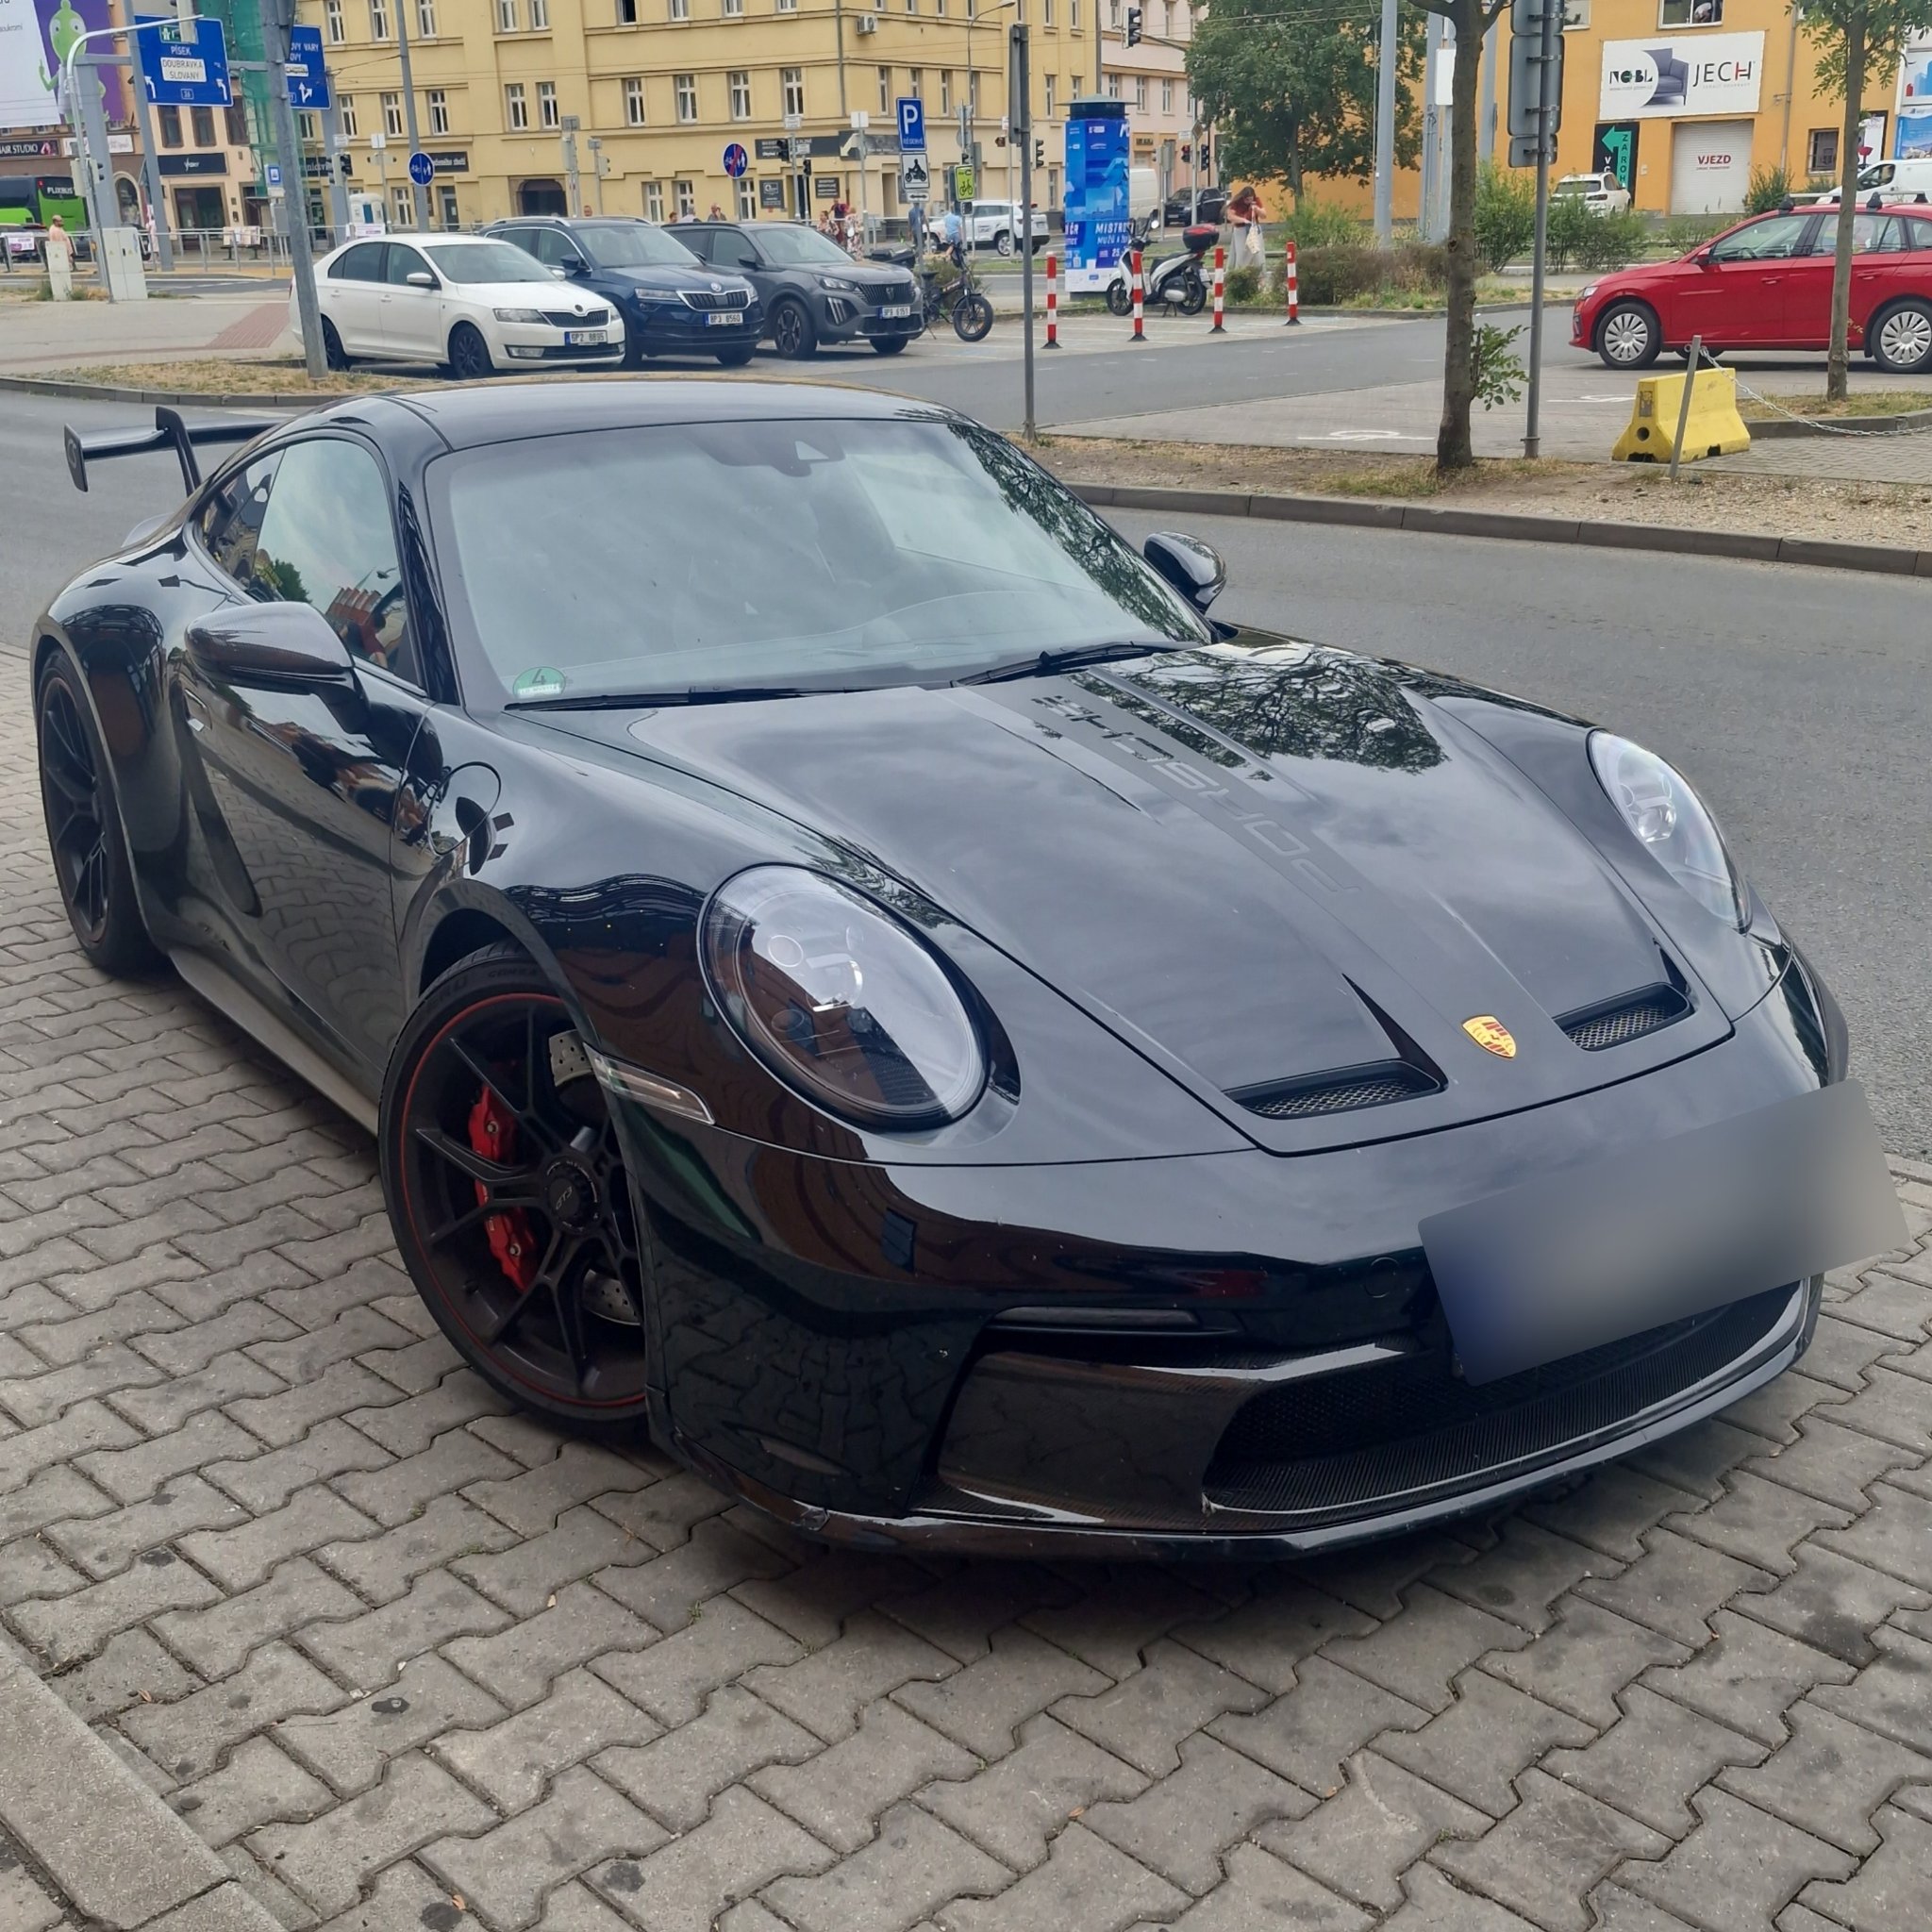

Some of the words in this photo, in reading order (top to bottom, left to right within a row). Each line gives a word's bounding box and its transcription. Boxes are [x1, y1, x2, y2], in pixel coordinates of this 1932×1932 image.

[170, 45, 192, 56] PÍSEK
[162, 59, 204, 69] DOUBRAVKA
[170, 70, 199, 80] SLOVANY
[1692, 60, 1753, 88] JECH
[903, 104, 919, 135] P
[13, 143, 39, 154] STUDIO
[1698, 154, 1732, 165] VJEZD
[47, 186, 74, 194] FLIXBUS
[1030, 695, 1361, 894] PORSCHE
